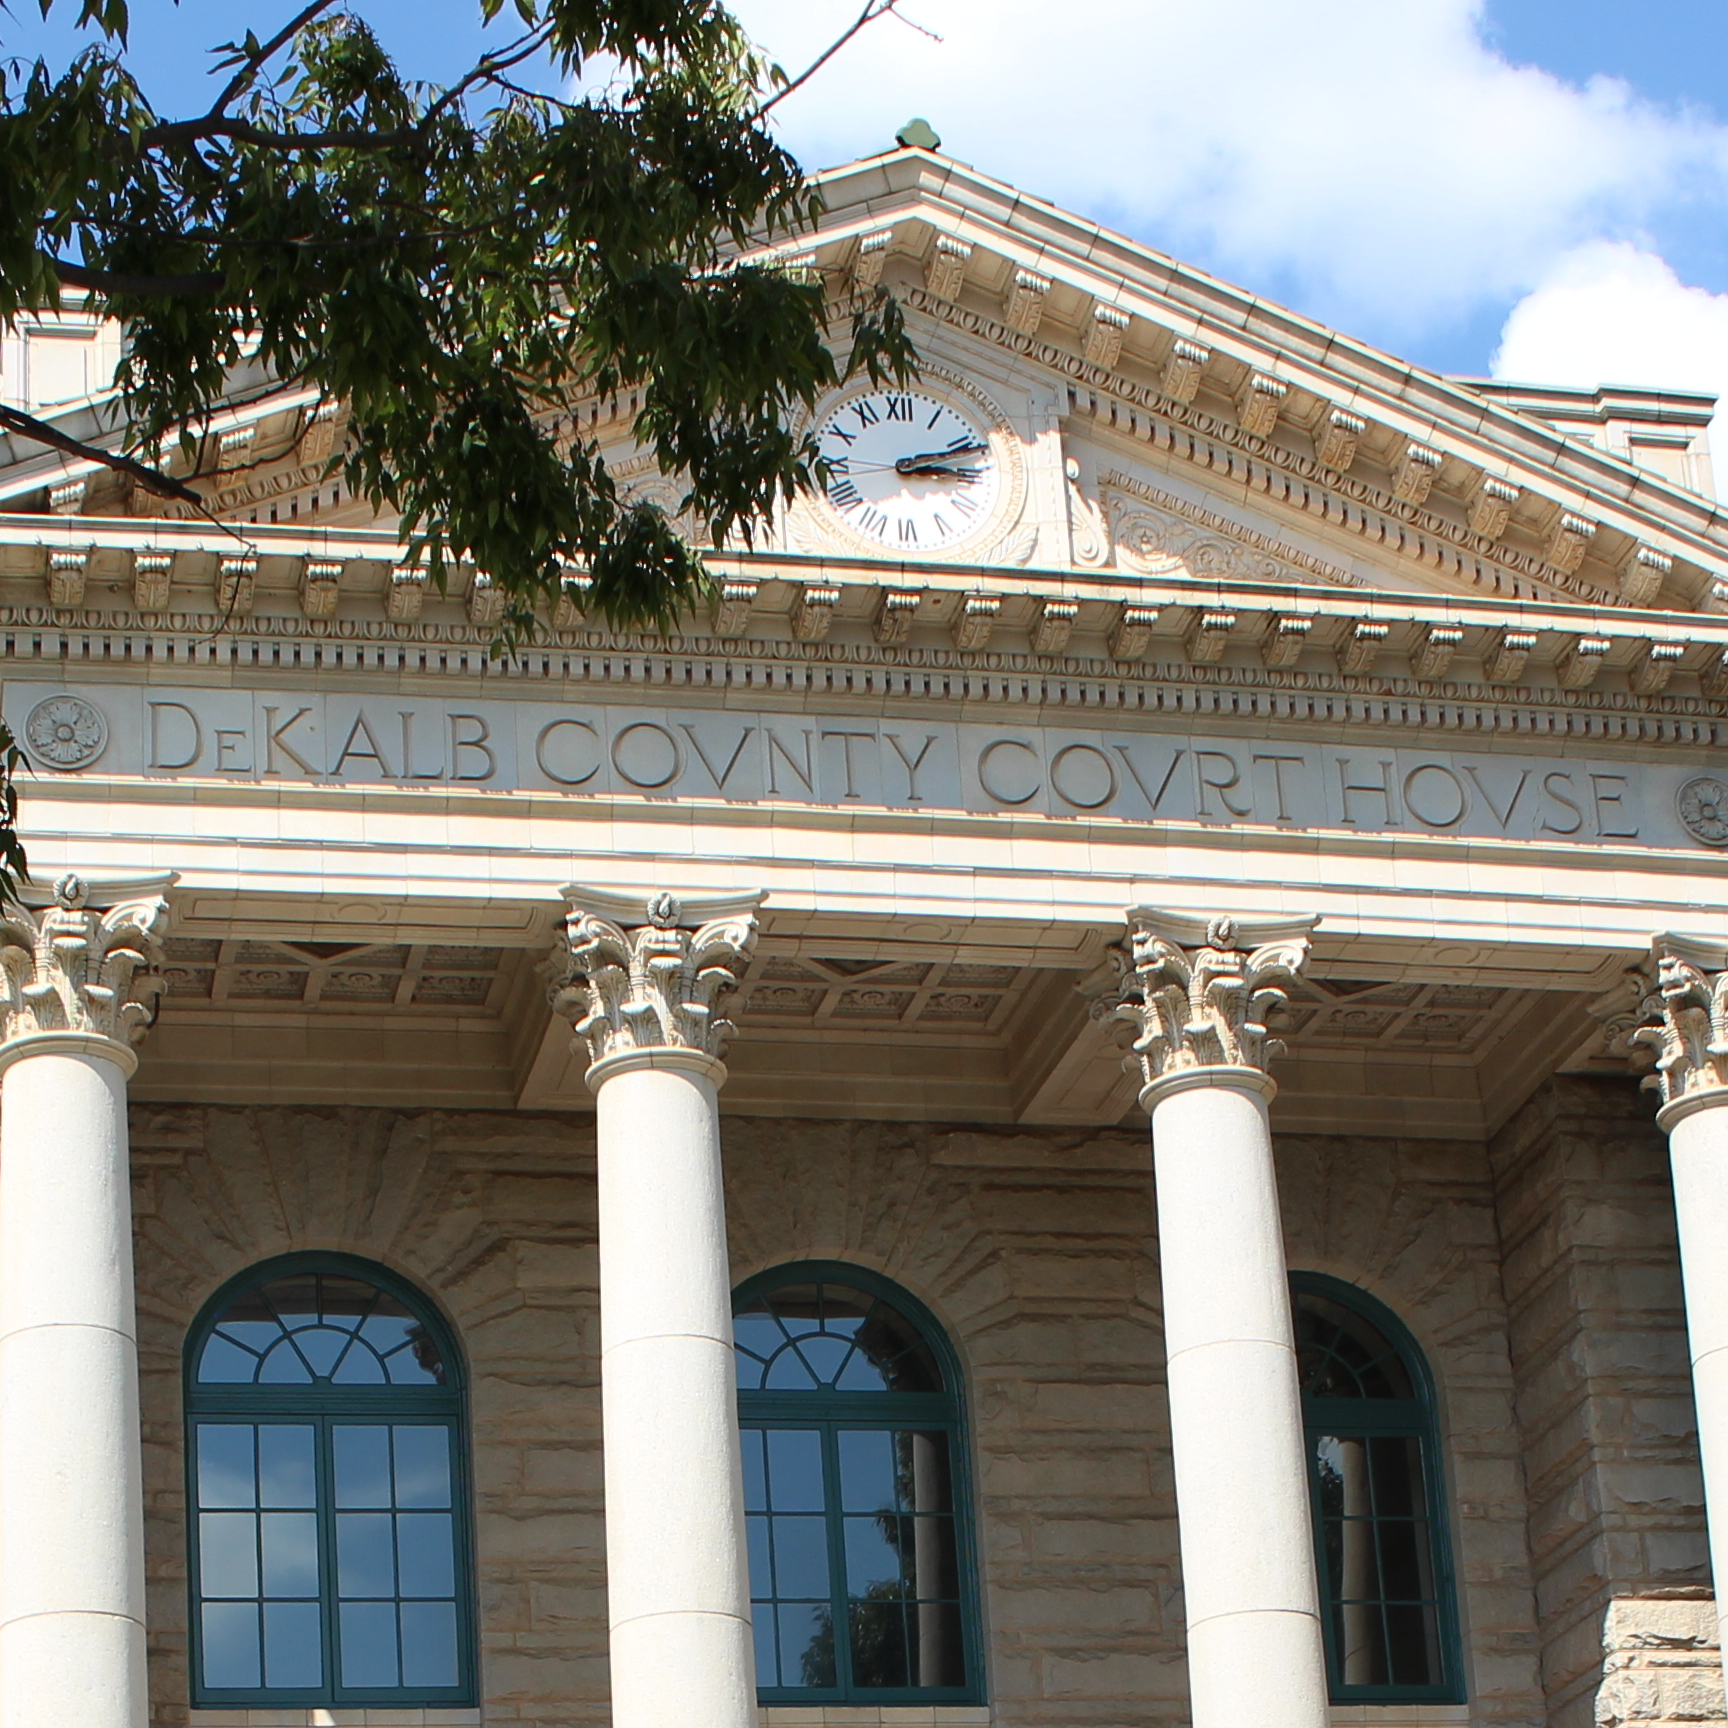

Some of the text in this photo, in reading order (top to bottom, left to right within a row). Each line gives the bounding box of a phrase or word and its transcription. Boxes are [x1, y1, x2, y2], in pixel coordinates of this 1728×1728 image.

[850, 399, 881, 430] XI
[885, 395, 914, 422] XII
[827, 422, 858, 447] X
